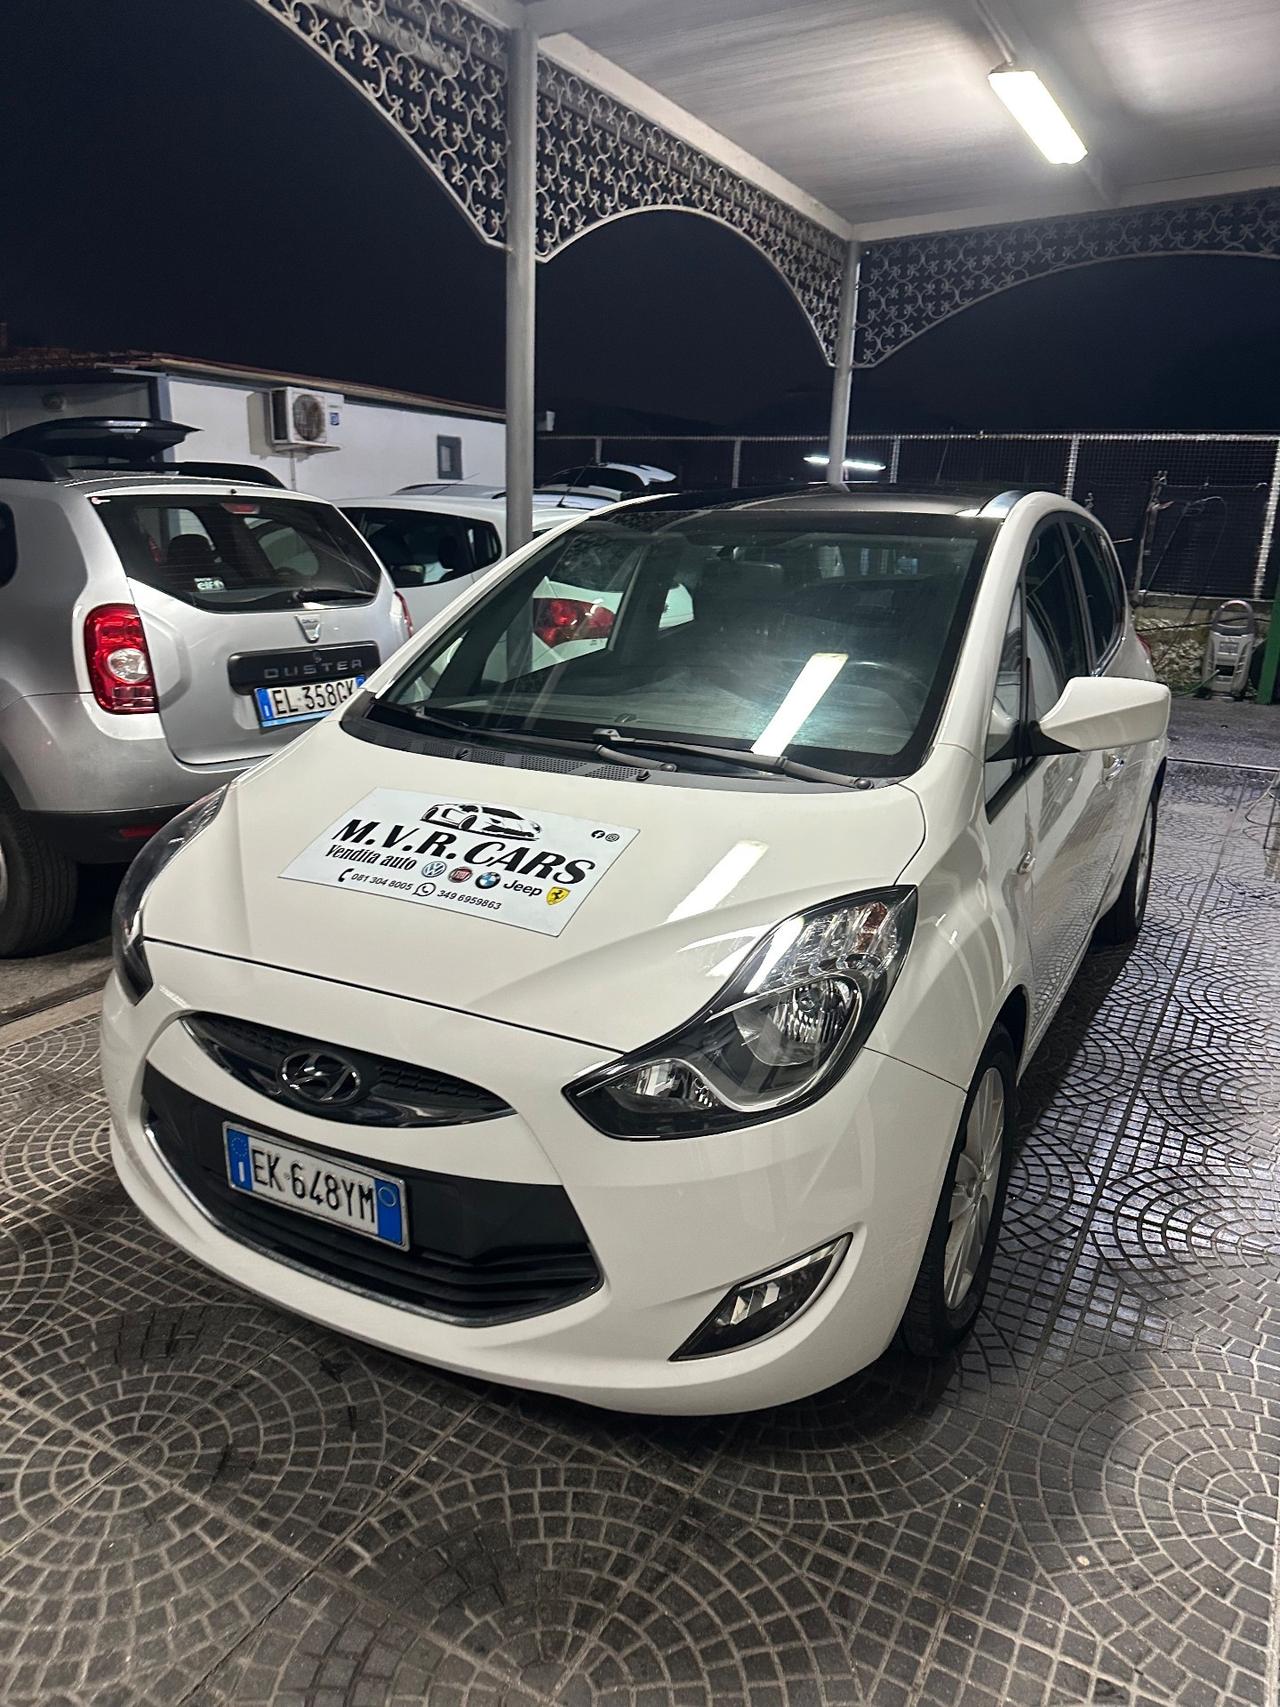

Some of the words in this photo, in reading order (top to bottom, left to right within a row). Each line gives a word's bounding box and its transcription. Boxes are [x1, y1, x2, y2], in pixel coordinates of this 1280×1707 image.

[264, 659, 363, 679] DUSTER
[272, 689, 298, 715] EL
[325, 844, 381, 865] Vendita
[380, 855, 417, 871] auto
[503, 880, 543, 897] Jeep
[351, 873, 369, 881] 081
[369, 876, 388, 886] 304
[388, 881, 413, 890] 8005
[437, 890, 457, 901] 349
[458, 894, 502, 910] 6959863
[252, 1149, 284, 1192] EK
[290, 1163, 375, 1223] 648YM
